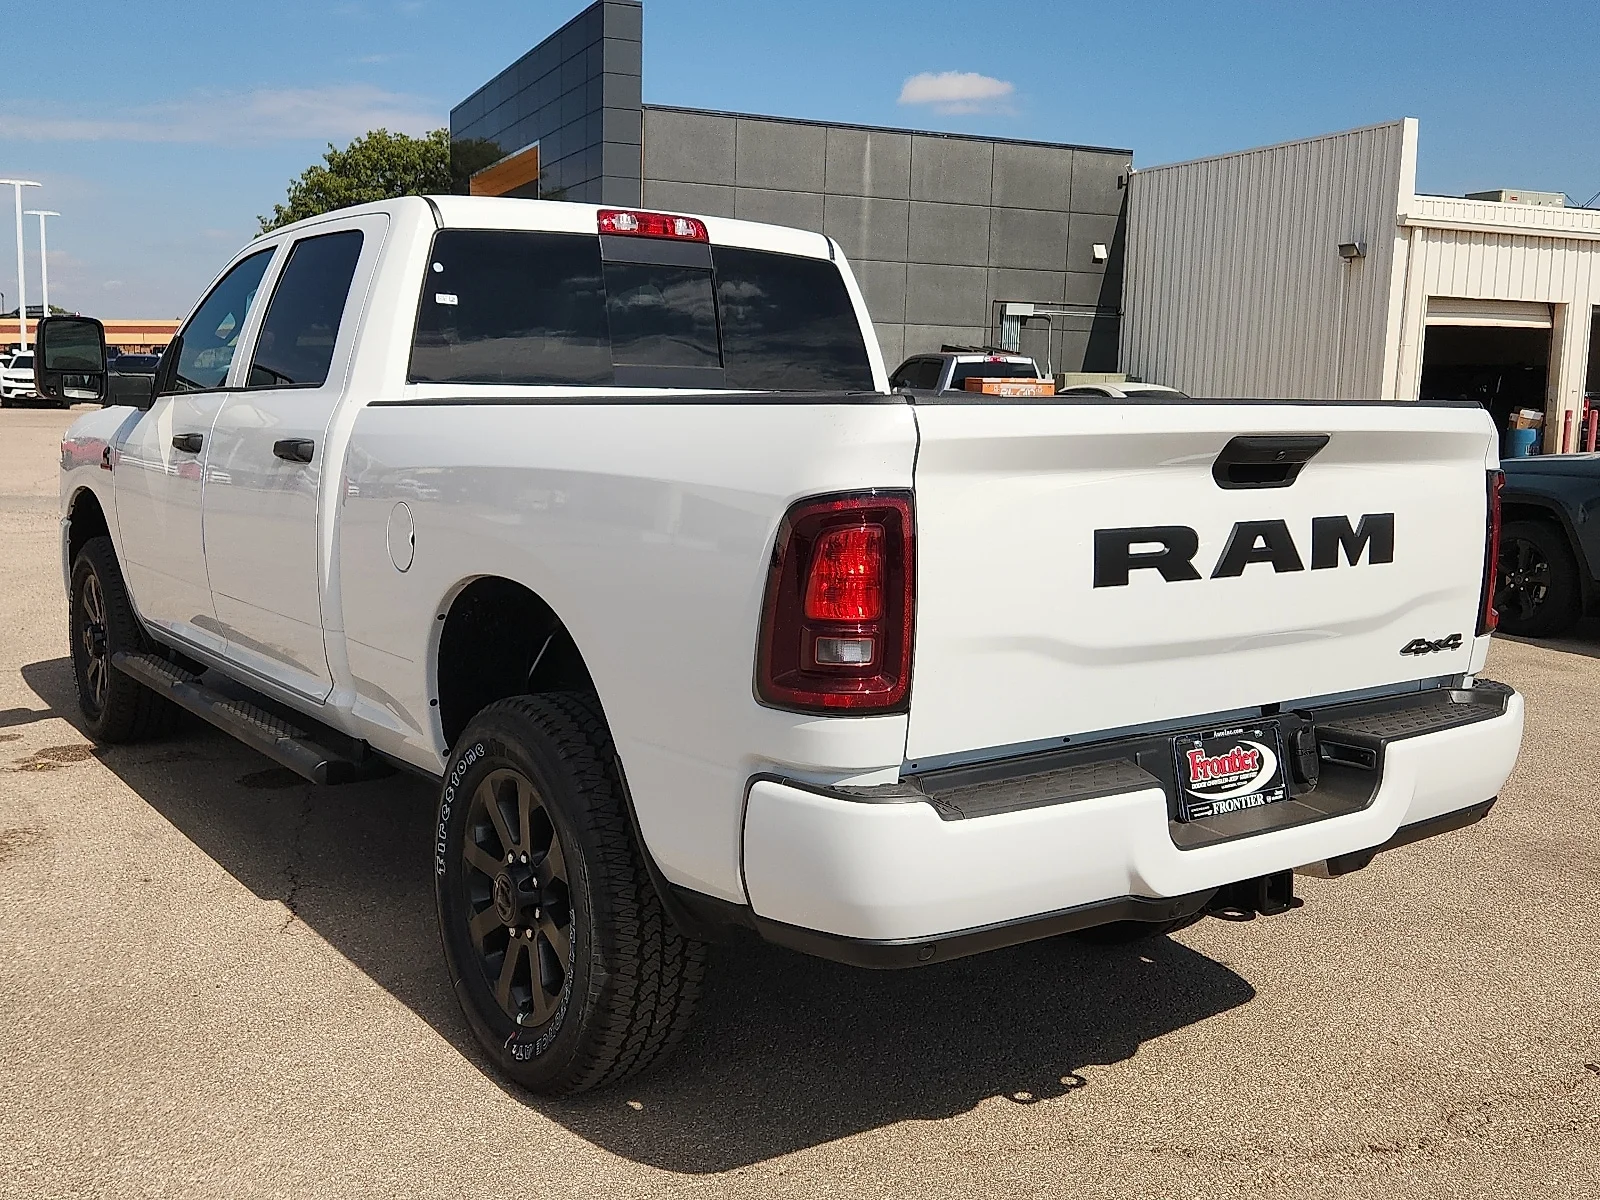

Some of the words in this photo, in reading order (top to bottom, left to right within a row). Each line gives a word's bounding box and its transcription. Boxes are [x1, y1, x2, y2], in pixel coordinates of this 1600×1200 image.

[1093, 513, 1394, 589] RAM
[1399, 633, 1463, 656] 4x4
[1187, 746, 1259, 781] Frontier
[1212, 793, 1265, 815] FRONTIER
